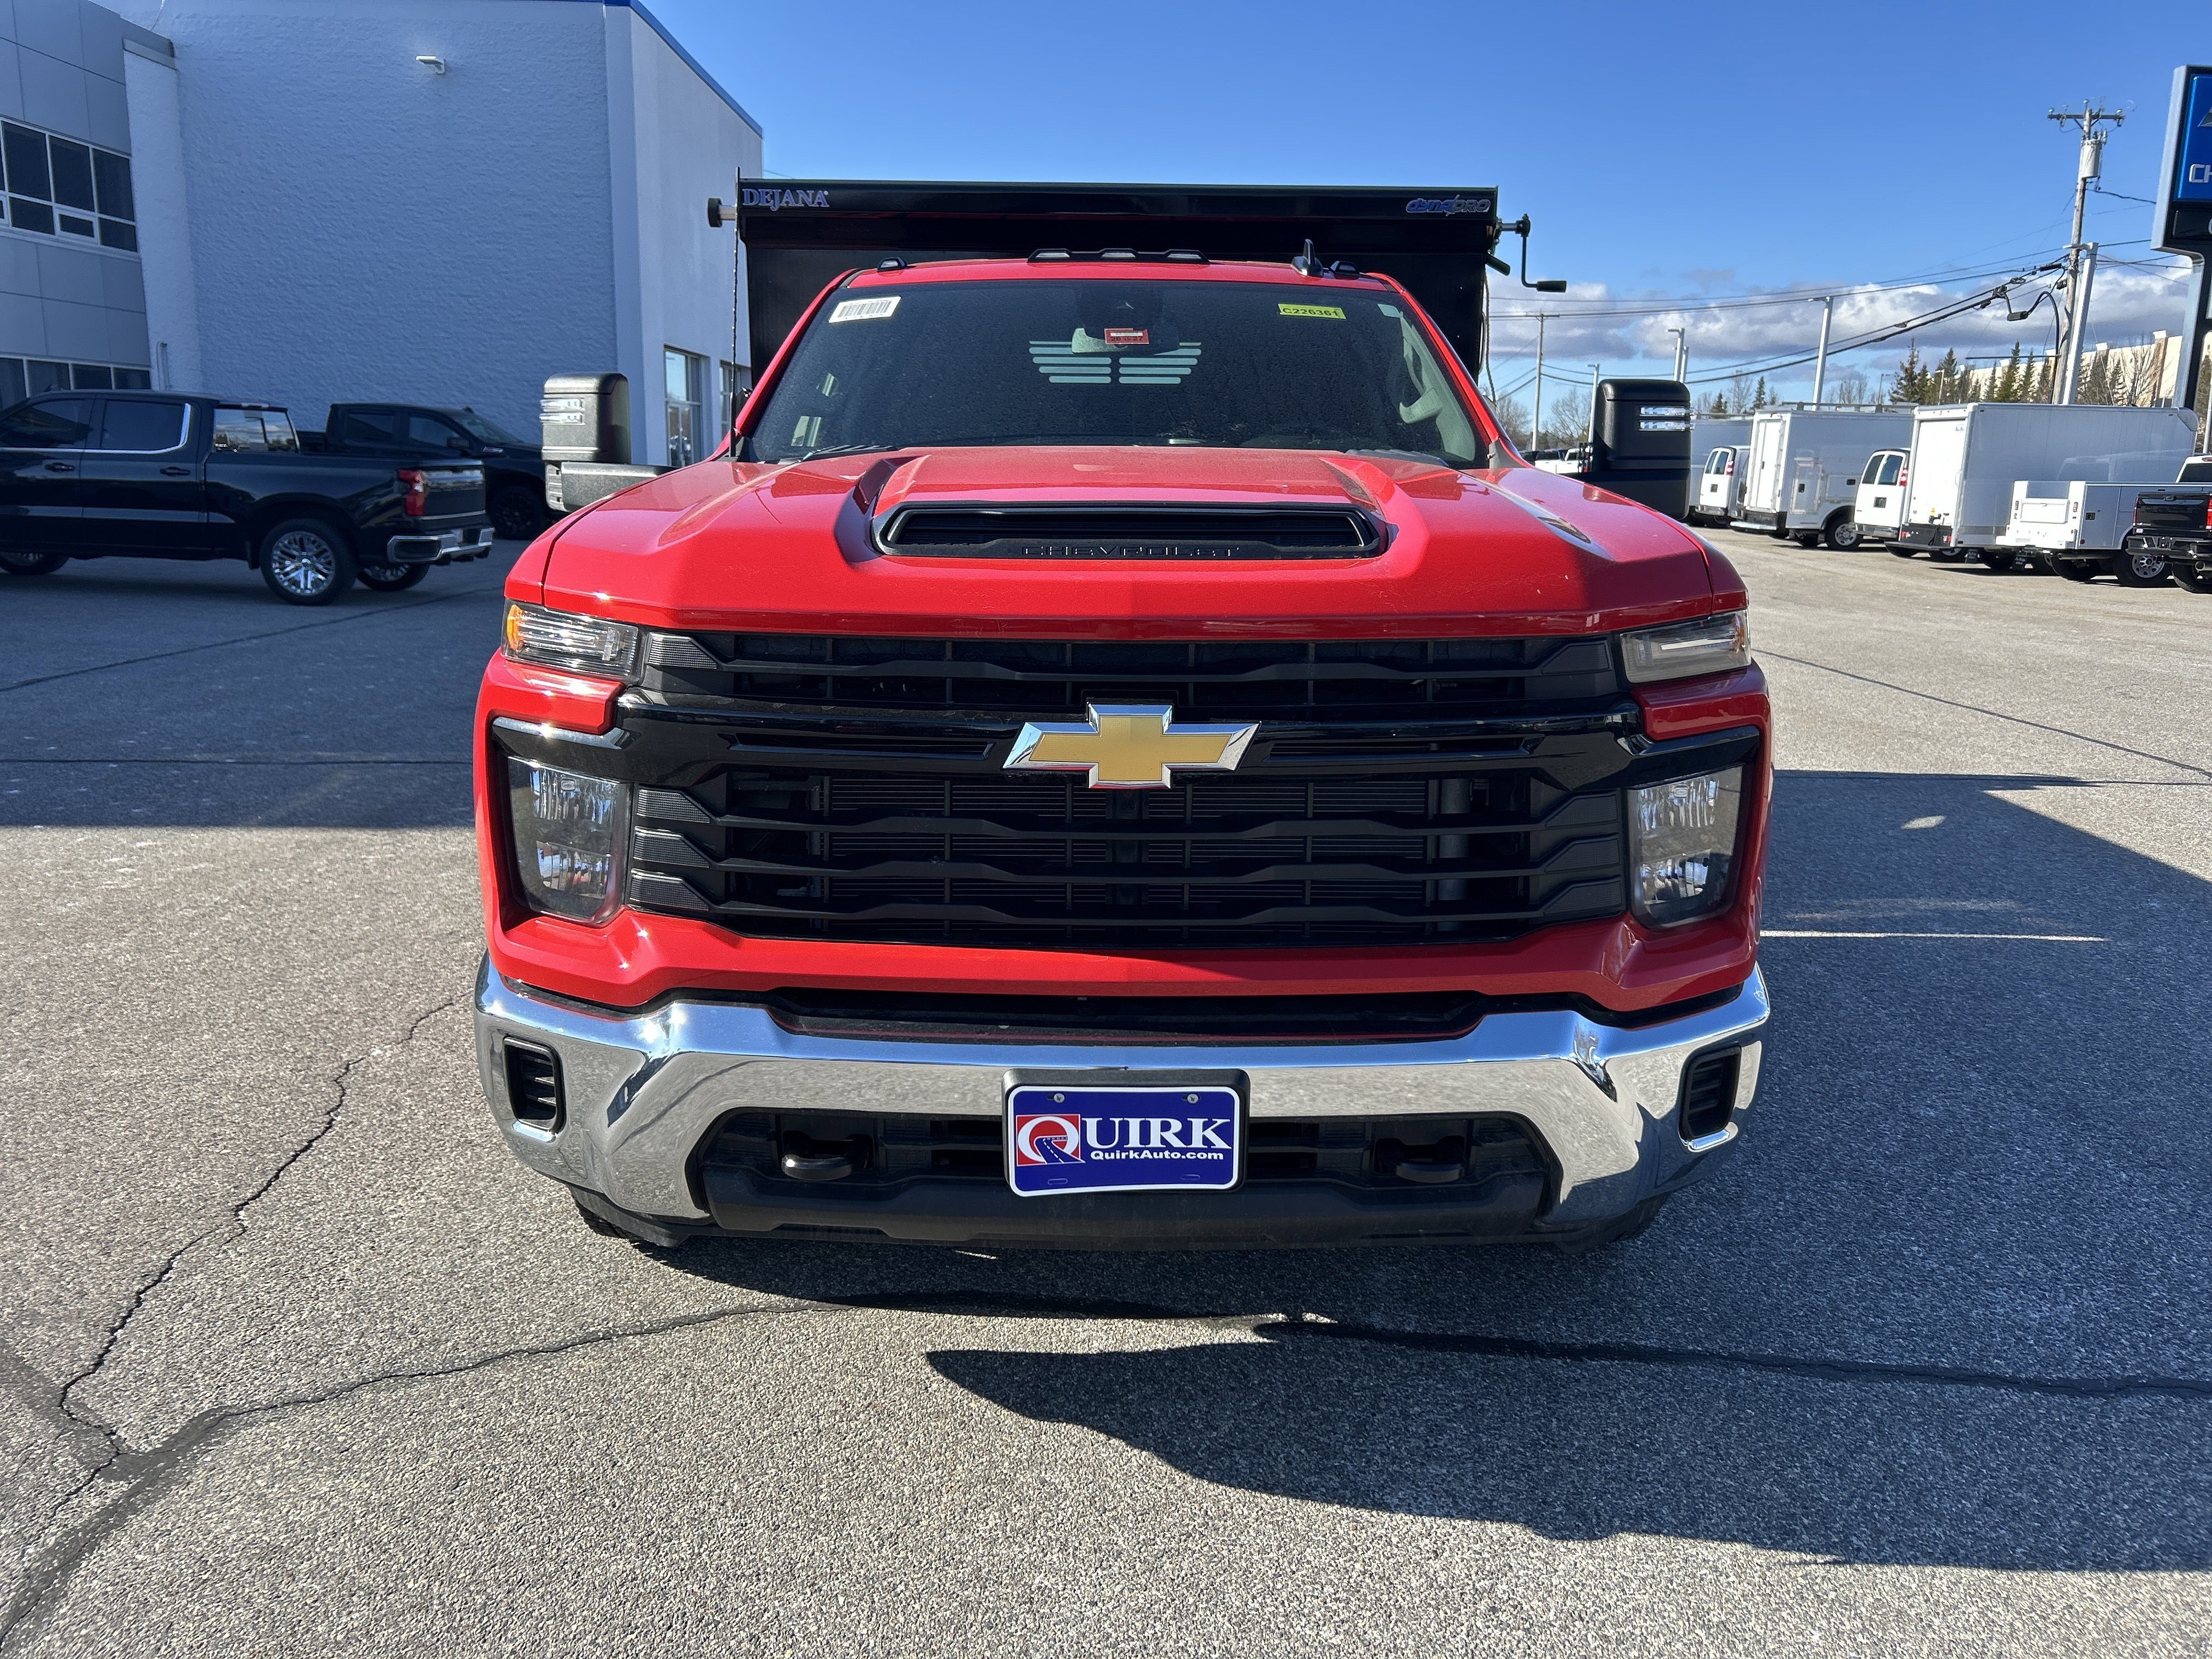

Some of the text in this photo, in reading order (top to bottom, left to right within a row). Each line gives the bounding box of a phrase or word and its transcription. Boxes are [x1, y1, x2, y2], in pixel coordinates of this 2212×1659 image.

[742, 189, 830, 211] DEJANA
[1283, 308, 1338, 317] C226361
[1022, 545, 1240, 557] CHEVROLET
[1018, 1116, 1232, 1164] QUIRK
[1090, 1149, 1224, 1160] QuirkAuto.com
